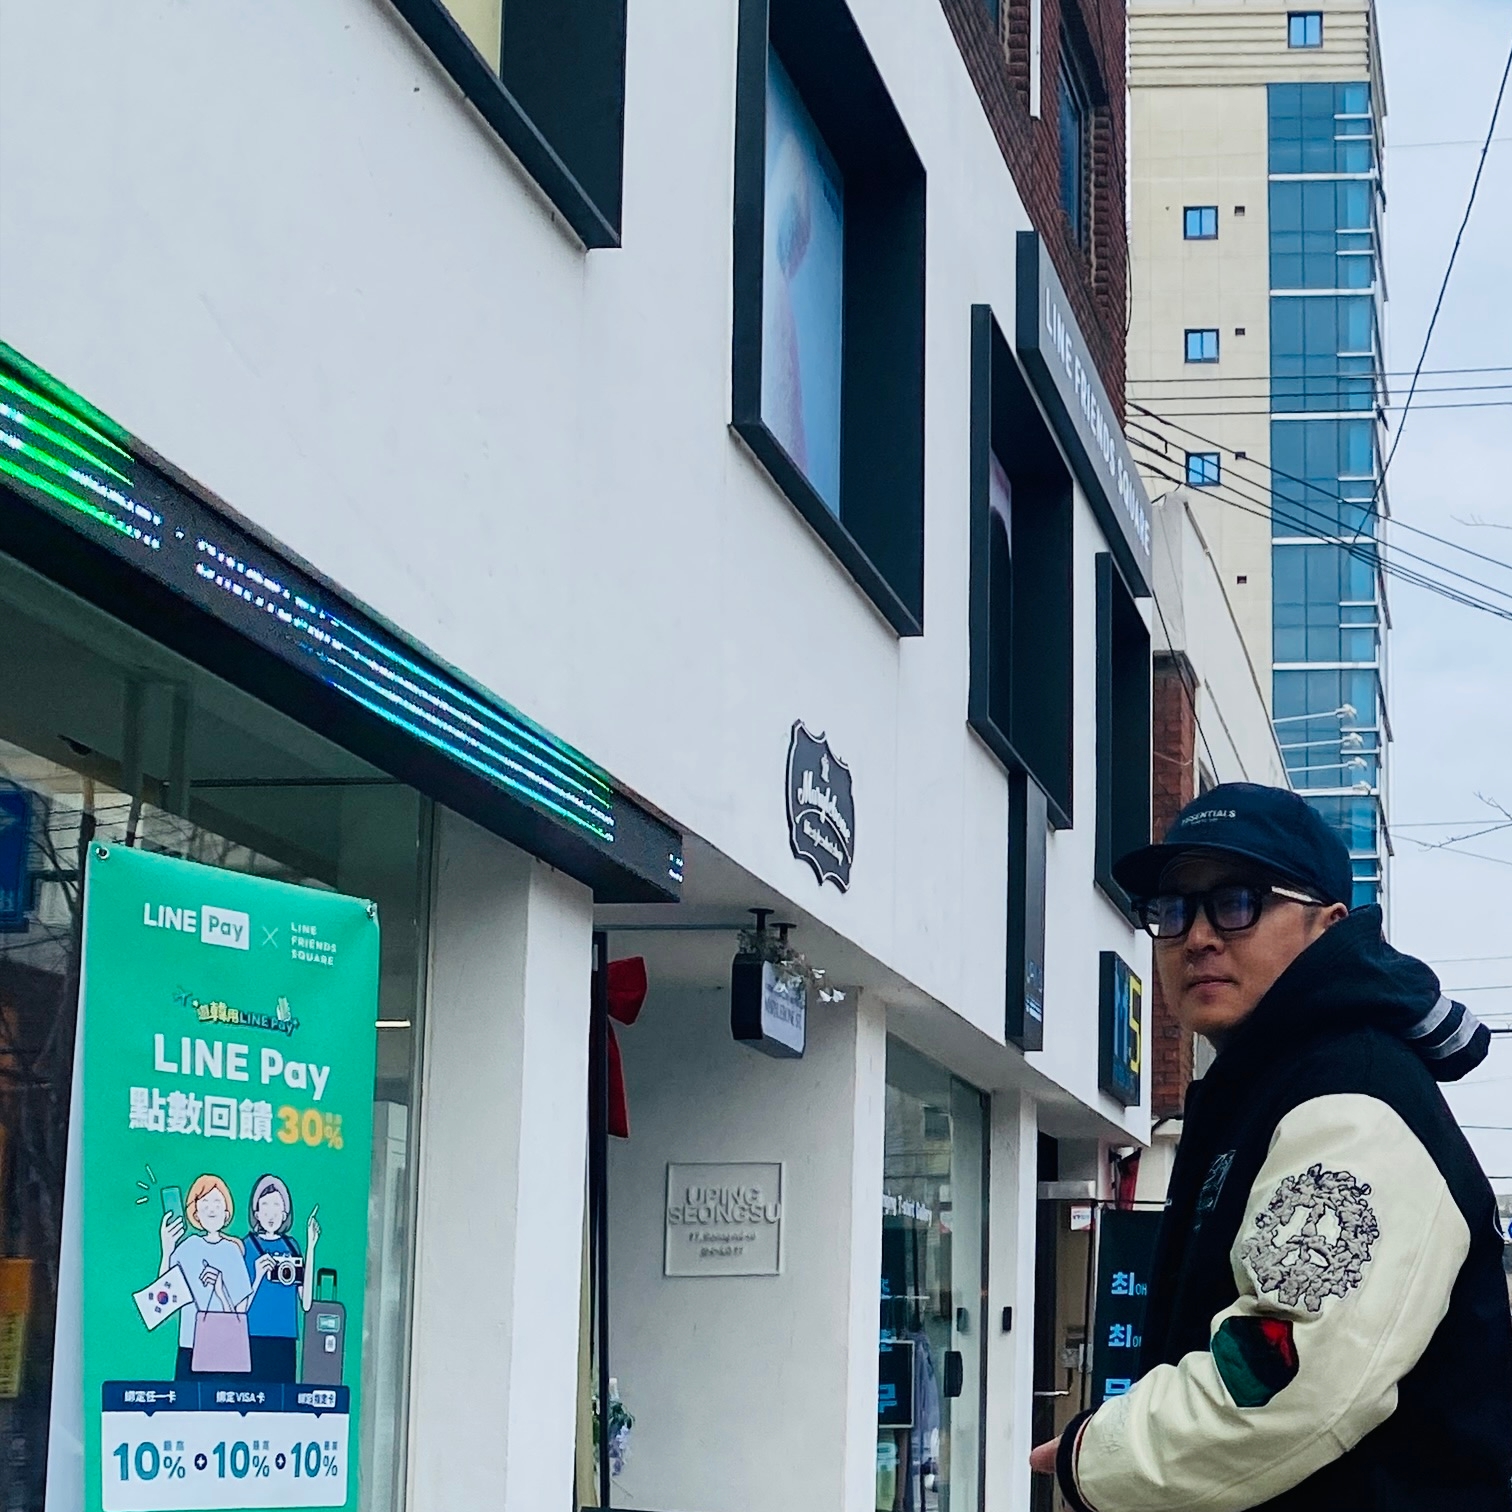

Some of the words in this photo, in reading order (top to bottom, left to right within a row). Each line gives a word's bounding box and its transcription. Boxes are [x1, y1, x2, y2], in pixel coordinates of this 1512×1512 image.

[1046, 286, 1073, 379] LINE
[1074, 358, 1116, 477] FRIENDS
[1117, 455, 1151, 557] SQUARE
[143, 902, 197, 933] LINE
[208, 914, 244, 943] Pay
[291, 921, 318, 936] LINE
[291, 935, 337, 953] FRIENDS
[291, 950, 334, 966] SQUARE
[154, 1033, 249, 1082] LINE
[261, 1047, 330, 1101] Pay
[129, 1086, 273, 1143] 點數回饋
[277, 1105, 344, 1151] 30%
[668, 1203, 781, 1225] SEONGSU
[113, 1441, 186, 1481] 10%
[212, 1440, 270, 1479] 10%
[290, 1441, 338, 1478] 10%
